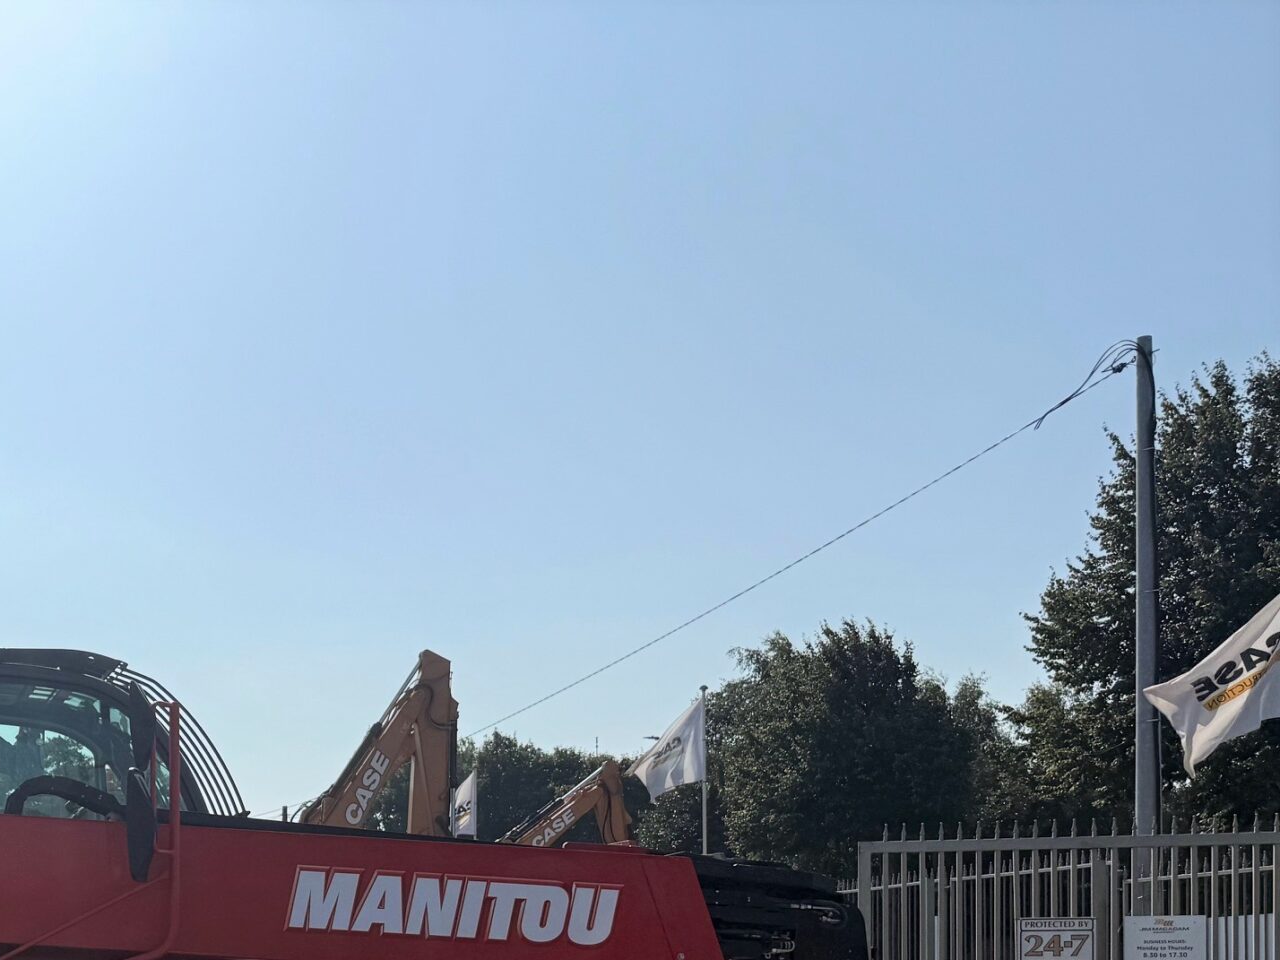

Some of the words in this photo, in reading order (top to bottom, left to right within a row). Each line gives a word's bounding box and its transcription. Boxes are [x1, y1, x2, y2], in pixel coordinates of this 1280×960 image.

[346, 750, 390, 826] CASE
[531, 810, 577, 848] CASE
[286, 867, 621, 946] MANITOU
[1024, 934, 1090, 957] 24-7
